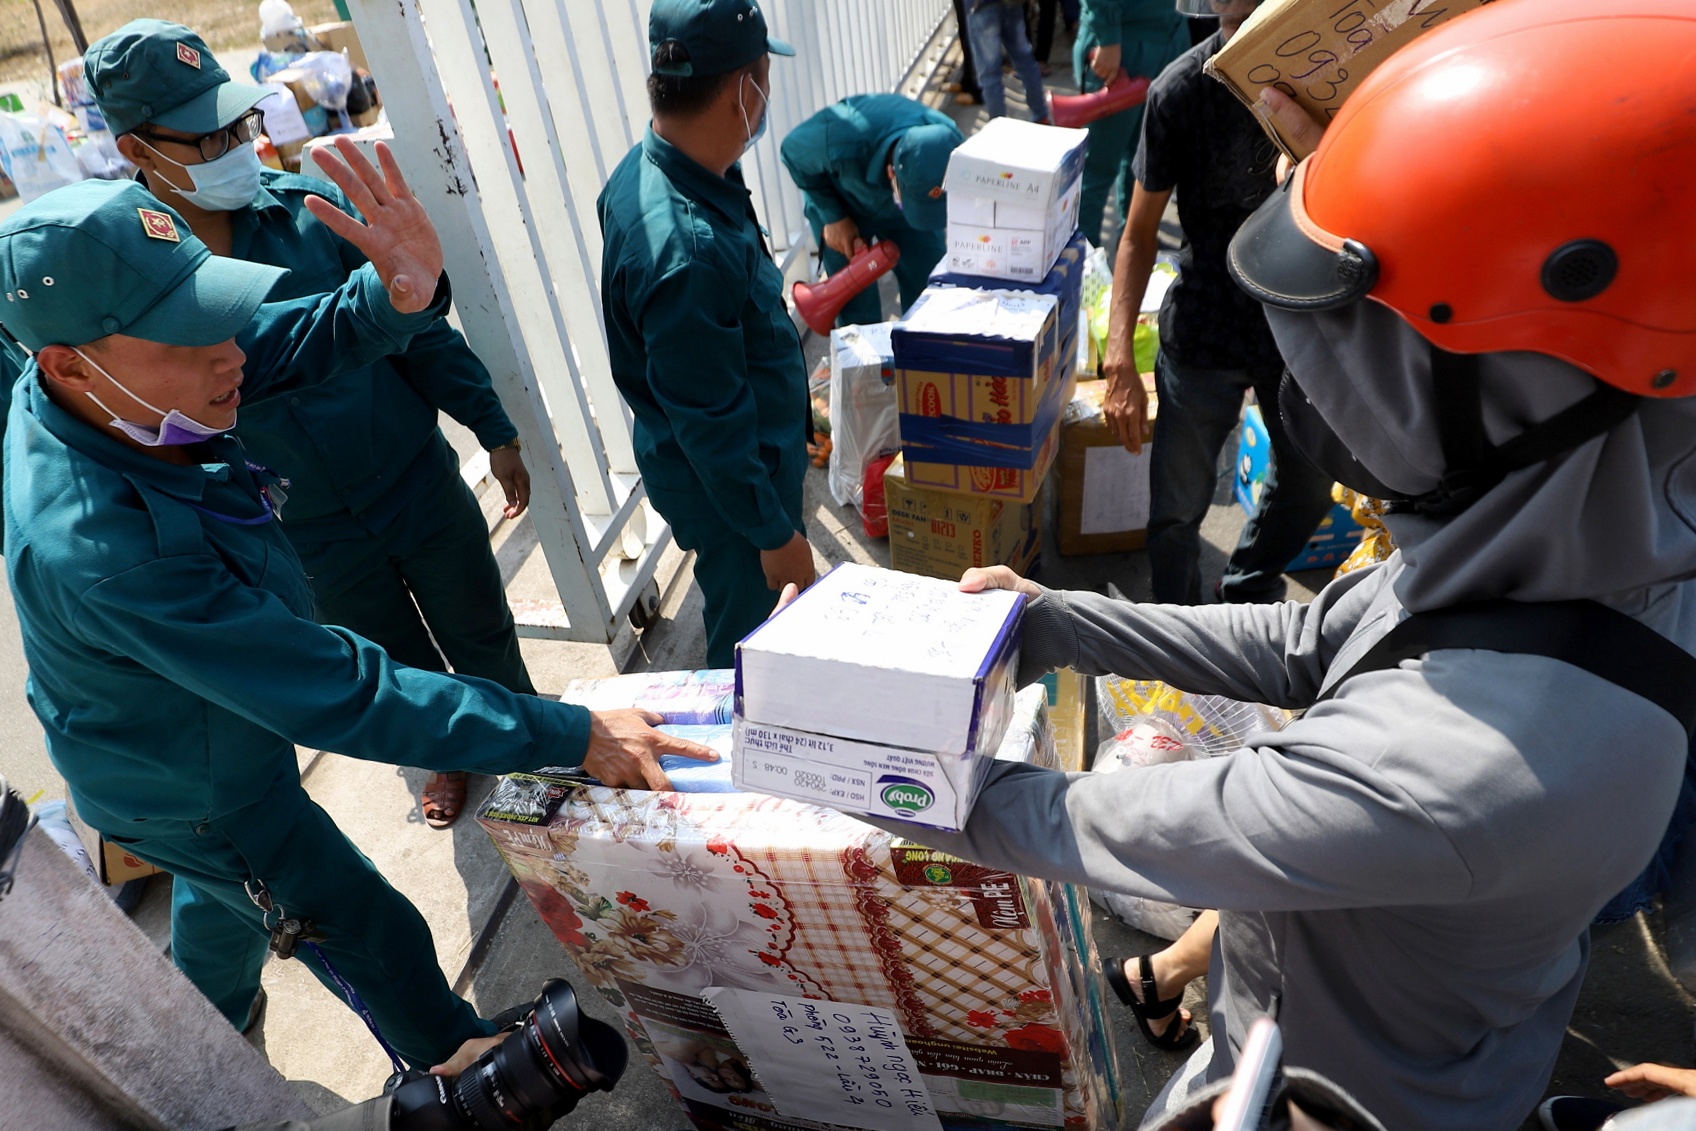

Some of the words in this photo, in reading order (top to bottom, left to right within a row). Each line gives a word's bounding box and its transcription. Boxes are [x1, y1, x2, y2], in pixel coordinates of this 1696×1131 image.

[975, 175, 1020, 190] PAPERLINE
[1026, 182, 1040, 194] A4
[954, 240, 1003, 253] PAPERLINE
[892, 509, 911, 519] DESK
[912, 513, 926, 523] FAN
[745, 727, 758, 736] ml)
[758, 729, 772, 739] 130
[779, 734, 795, 744] chai
[795, 736, 807, 747] (24
[817, 741, 835, 753] 3,12
[851, 777, 866, 787] NSX
[850, 791, 865, 801] HSD
[887, 789, 928, 807] Proby
[905, 850, 931, 862] LONG
[980, 882, 1012, 898] PE
[814, 1035, 840, 1060] 522
